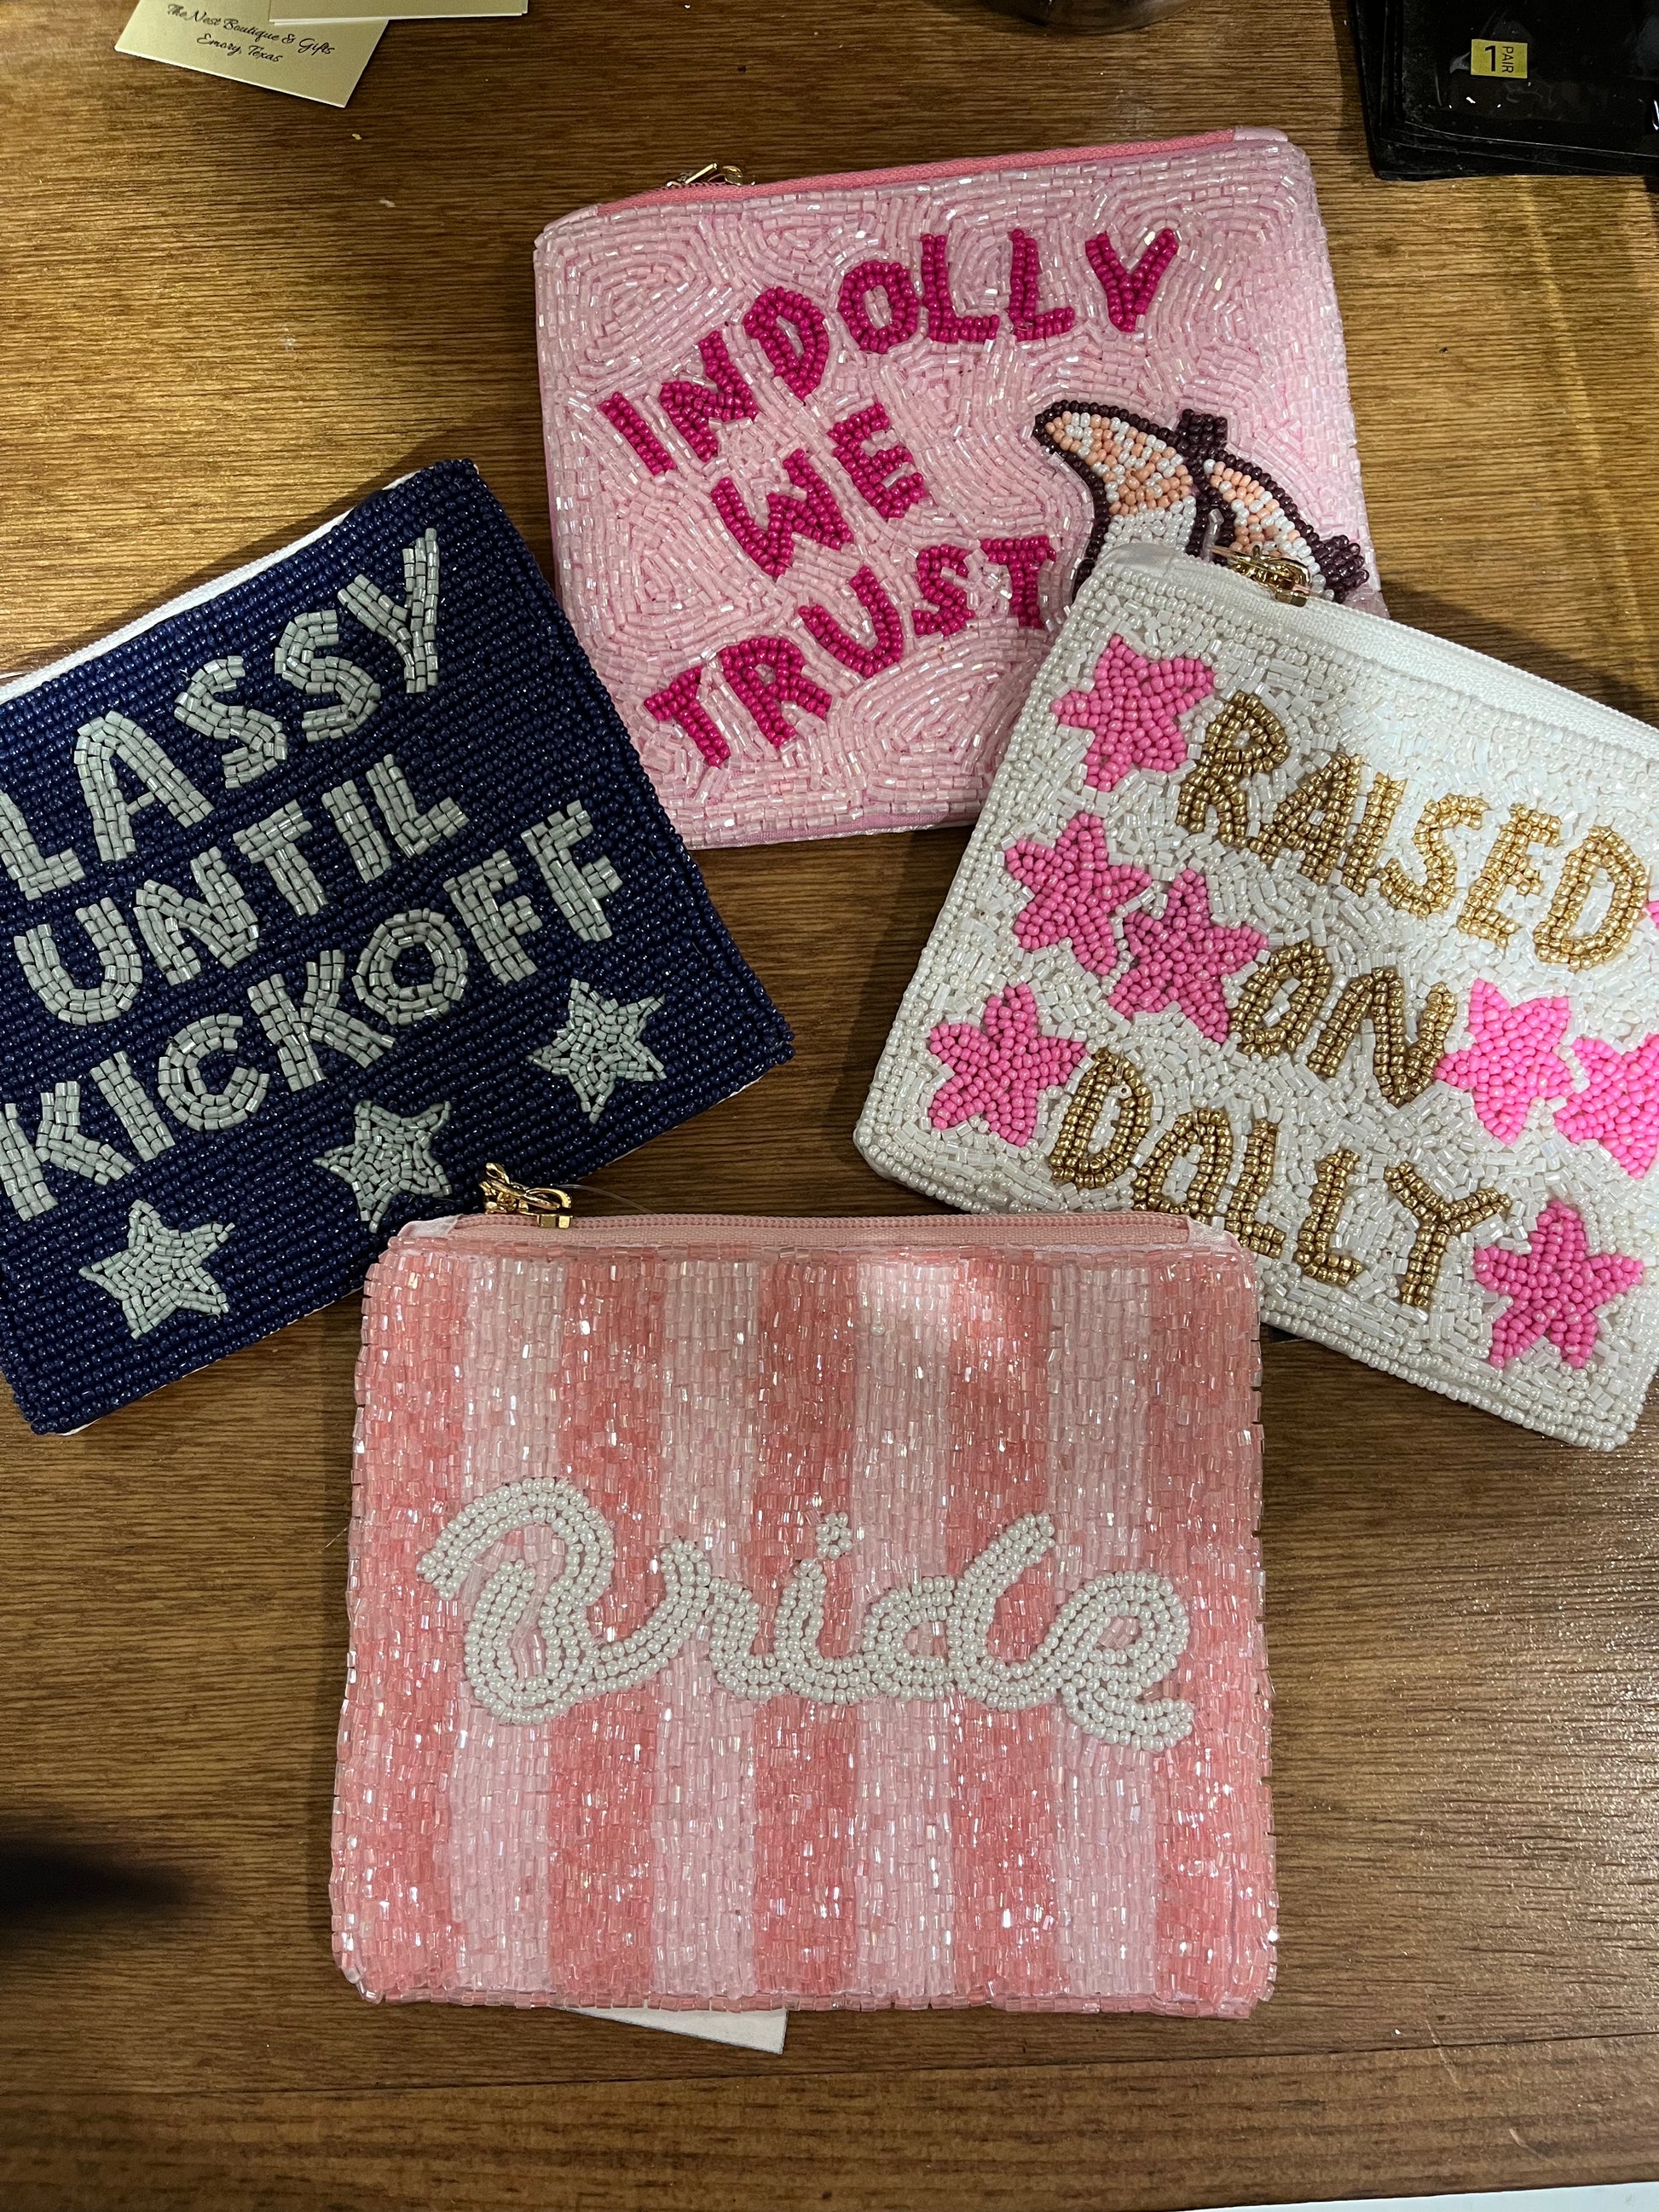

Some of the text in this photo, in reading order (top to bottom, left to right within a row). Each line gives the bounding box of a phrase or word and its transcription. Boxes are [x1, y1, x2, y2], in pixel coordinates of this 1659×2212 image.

[167, 3, 336, 56] The Nest Boutique & Gifts
[196, 32, 284, 63] Emory, Texas
[1484, 44, 1496, 72] 1
[1501, 46, 1514, 73] PAIR
[598, 228, 1180, 476] IN DOLLY
[711, 402, 927, 579] WE
[0, 527, 441, 902] LASSY
[643, 534, 1058, 768] TRUST
[14, 754, 469, 1026] UNTIL
[1175, 690, 1649, 973] RAISED
[0, 800, 624, 1222] KICKOFF
[1228, 939, 1458, 1107] ON
[1049, 1048, 1512, 1307] DOLLY
[415, 1476, 1194, 1753] Bride
